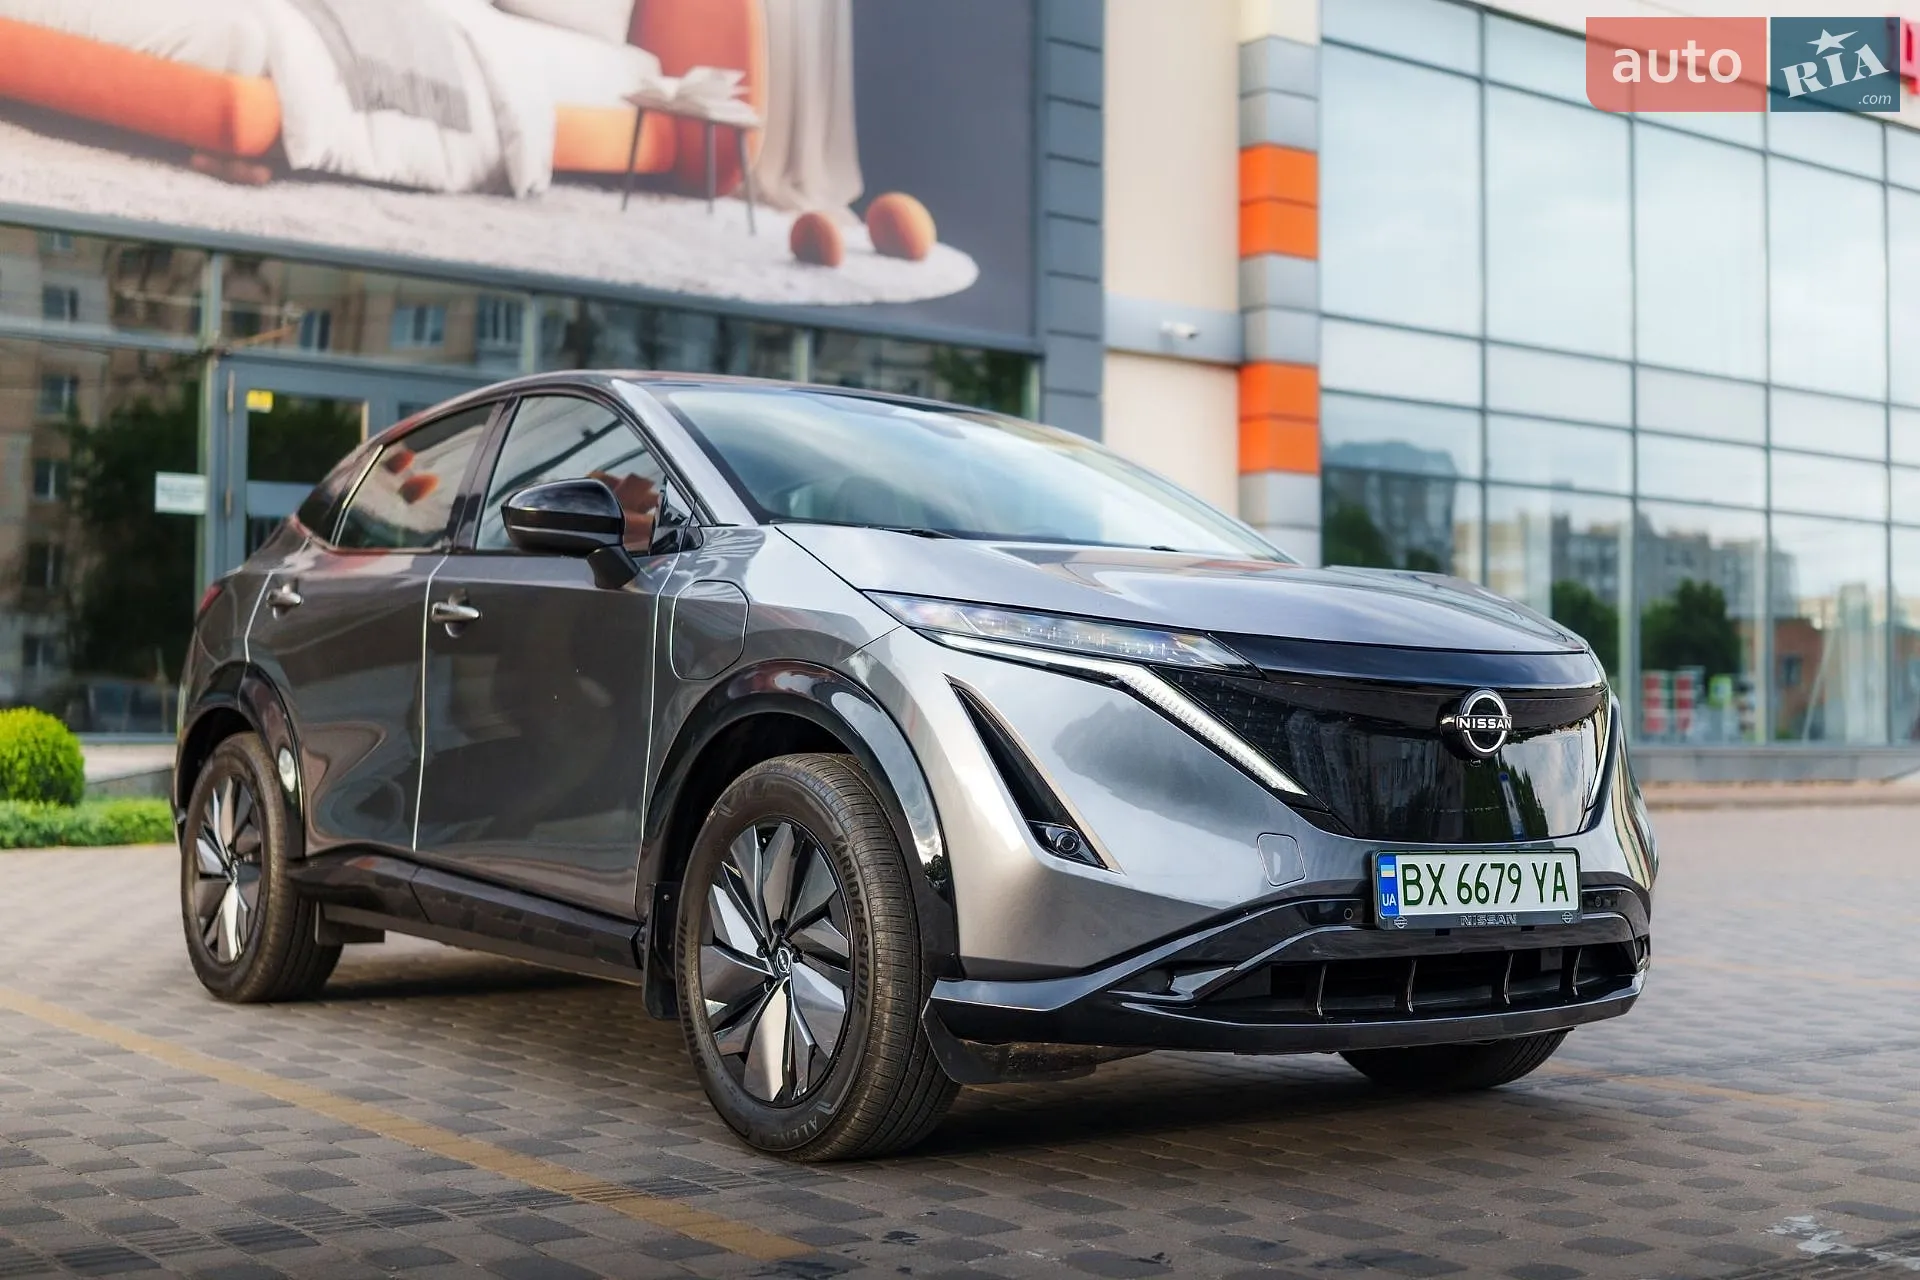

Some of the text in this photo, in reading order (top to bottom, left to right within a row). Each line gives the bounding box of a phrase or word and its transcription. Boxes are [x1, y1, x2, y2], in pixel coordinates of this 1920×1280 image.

[1458, 717, 1512, 729] NISSAN
[1401, 861, 1569, 906] BX 6679 YA
[1382, 893, 1397, 907] UA
[1460, 914, 1517, 926] NISSAN
